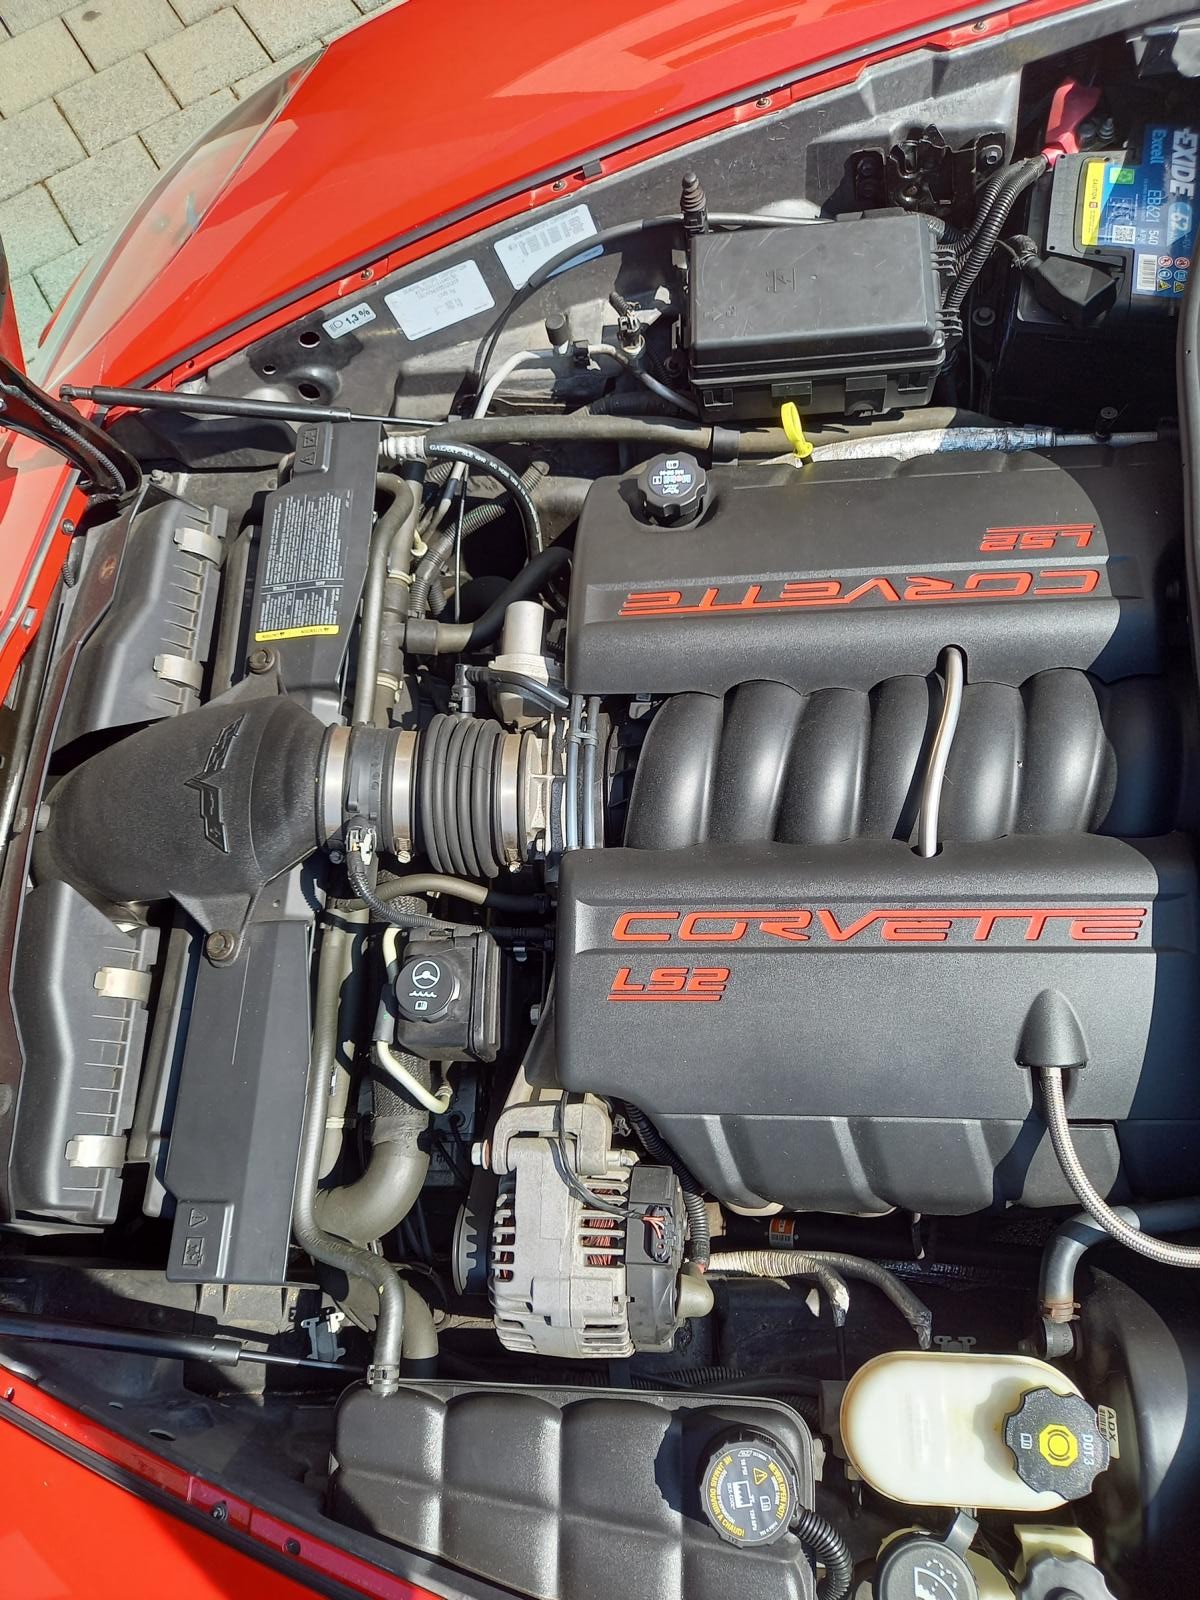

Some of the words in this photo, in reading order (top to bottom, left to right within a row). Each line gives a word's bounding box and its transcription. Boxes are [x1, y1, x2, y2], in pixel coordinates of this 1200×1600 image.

[1150, 128, 1167, 164] Excell
[1169, 126, 1199, 198] EXIDE
[1145, 189, 1162, 223] EB621
[1149, 229, 1159, 245] 540
[346, 313, 359, 325] 1,3
[358, 308, 370, 318] %
[979, 527, 1094, 552] LS2
[617, 569, 1100, 617] CORVETTE
[610, 907, 1148, 942] CORVETTE
[608, 966, 729, 995] LS2
[1107, 1409, 1117, 1442] ADX
[1082, 1433, 1095, 1457] DOT
[710, 1461, 726, 1487] JAMAIS
[709, 1488, 720, 1515] OUVRIR
[721, 1518, 745, 1537] CHAUD!
